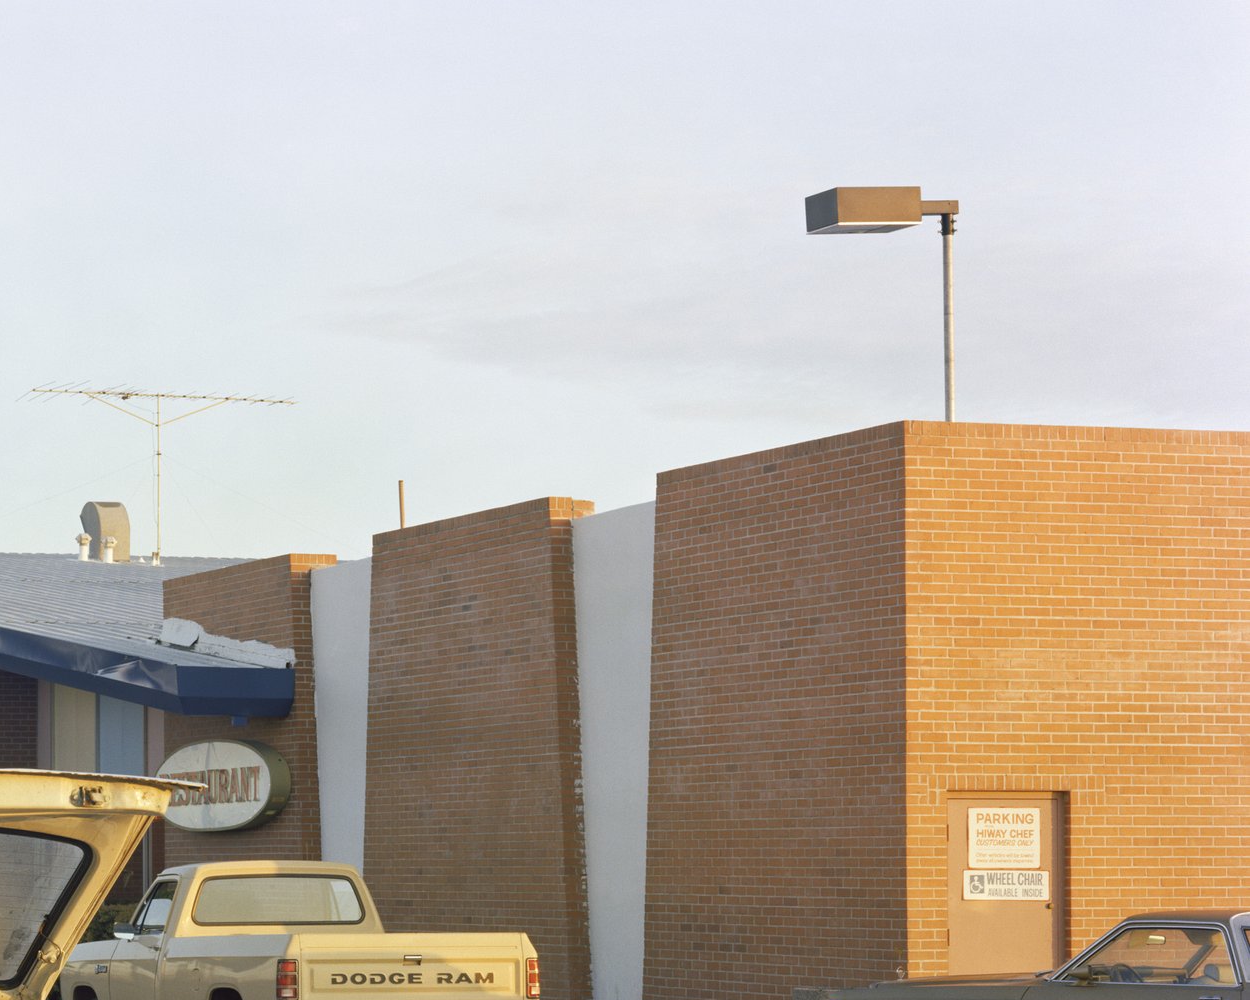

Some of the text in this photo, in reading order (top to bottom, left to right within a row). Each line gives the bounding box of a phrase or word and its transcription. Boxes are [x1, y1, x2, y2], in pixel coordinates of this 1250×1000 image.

[976, 813, 1034, 824] PARKING
[976, 829, 1034, 838] HIWAY CHEF
[976, 839, 1015, 847] CUSTOMERS
[986, 872, 1043, 886] WHEEL CHAIR
[988, 888, 1043, 897] AVAILABLE INSIDE
[331, 973, 494, 985] DODGE RAM
